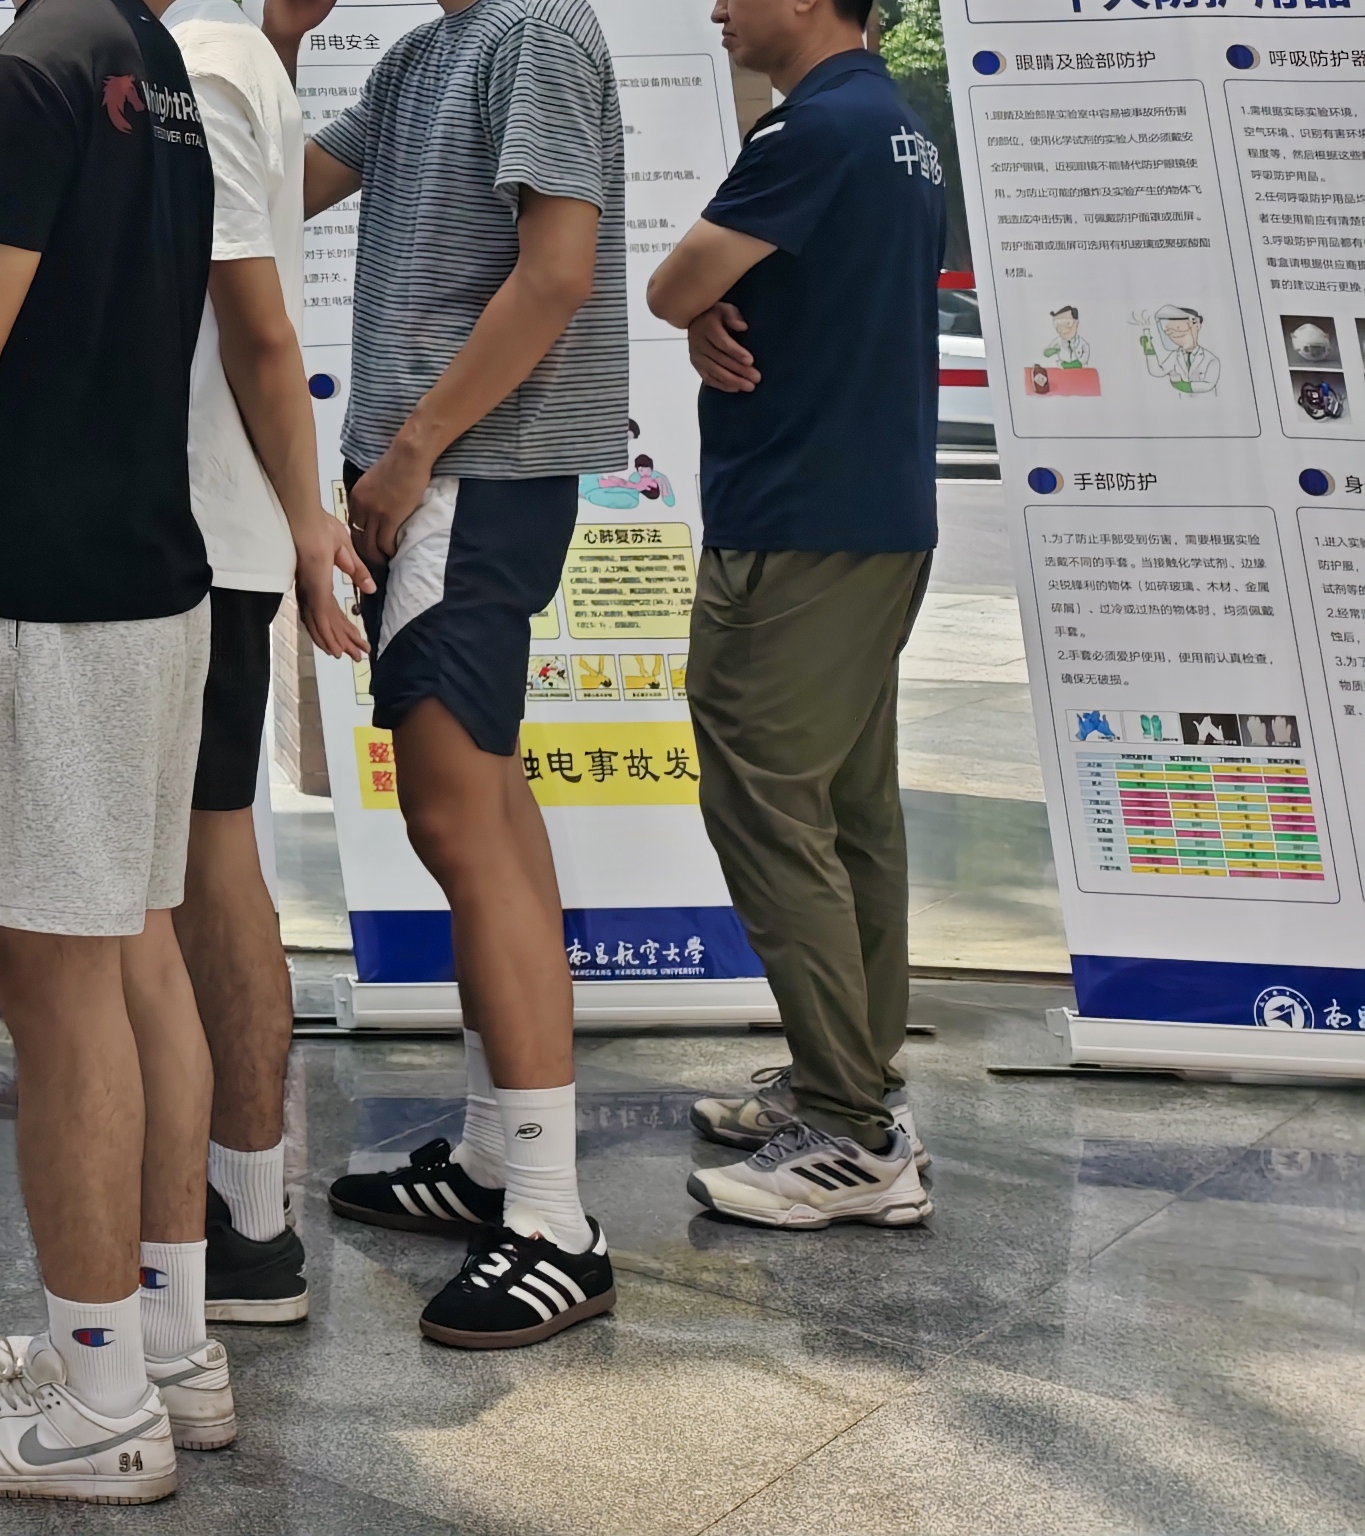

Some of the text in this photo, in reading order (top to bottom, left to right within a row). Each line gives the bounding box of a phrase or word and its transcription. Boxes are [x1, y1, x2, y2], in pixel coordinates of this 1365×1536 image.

[310, 33, 381, 50] 用电安全
[1015, 50, 1156, 71] 眼睛及脸部防护
[891, 125, 946, 188] 中国移
[1262, 235, 1365, 249] 3.呼吸防护用品都有
[1073, 471, 1158, 492] 手部防护
[1345, 475, 1364, 494] 身
[583, 528, 663, 544] 心肺复苏法
[118, 1450, 144, 1473] 94
